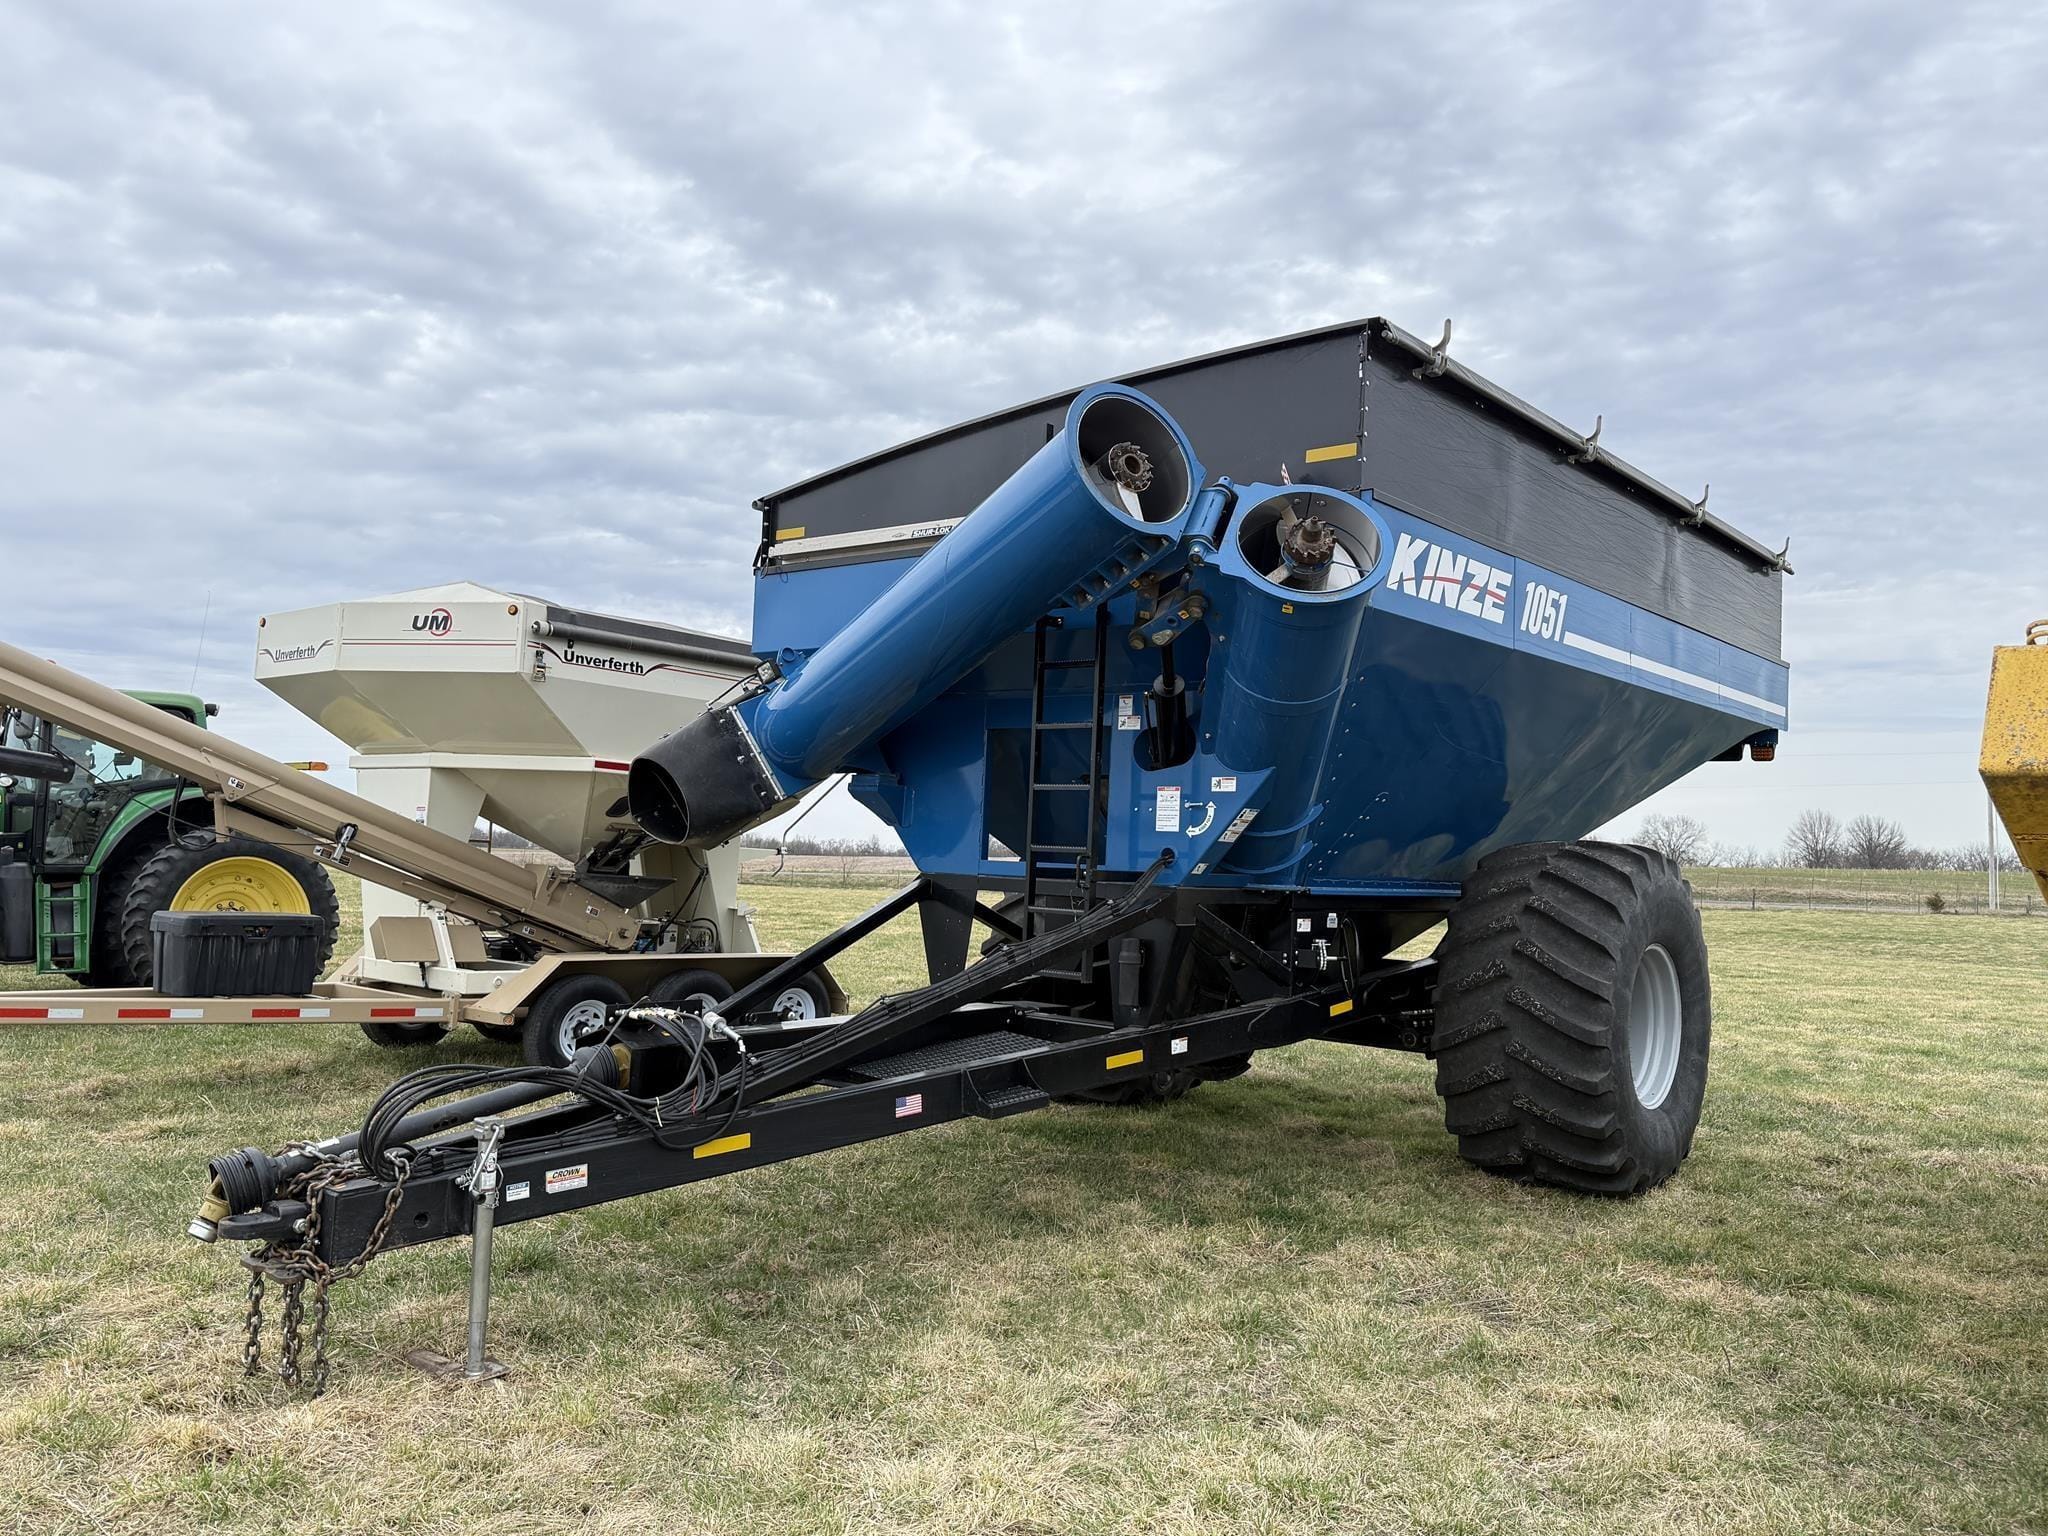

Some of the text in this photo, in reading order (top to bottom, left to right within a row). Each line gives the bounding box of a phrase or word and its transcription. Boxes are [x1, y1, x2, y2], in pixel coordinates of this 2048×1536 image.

[1387, 532, 1568, 642] KINZE 1051
[412, 615, 449, 631] UM
[275, 645, 315, 661] Unverferth
[563, 649, 644, 674] Unverferth
[552, 1167, 581, 1179] CROWN
